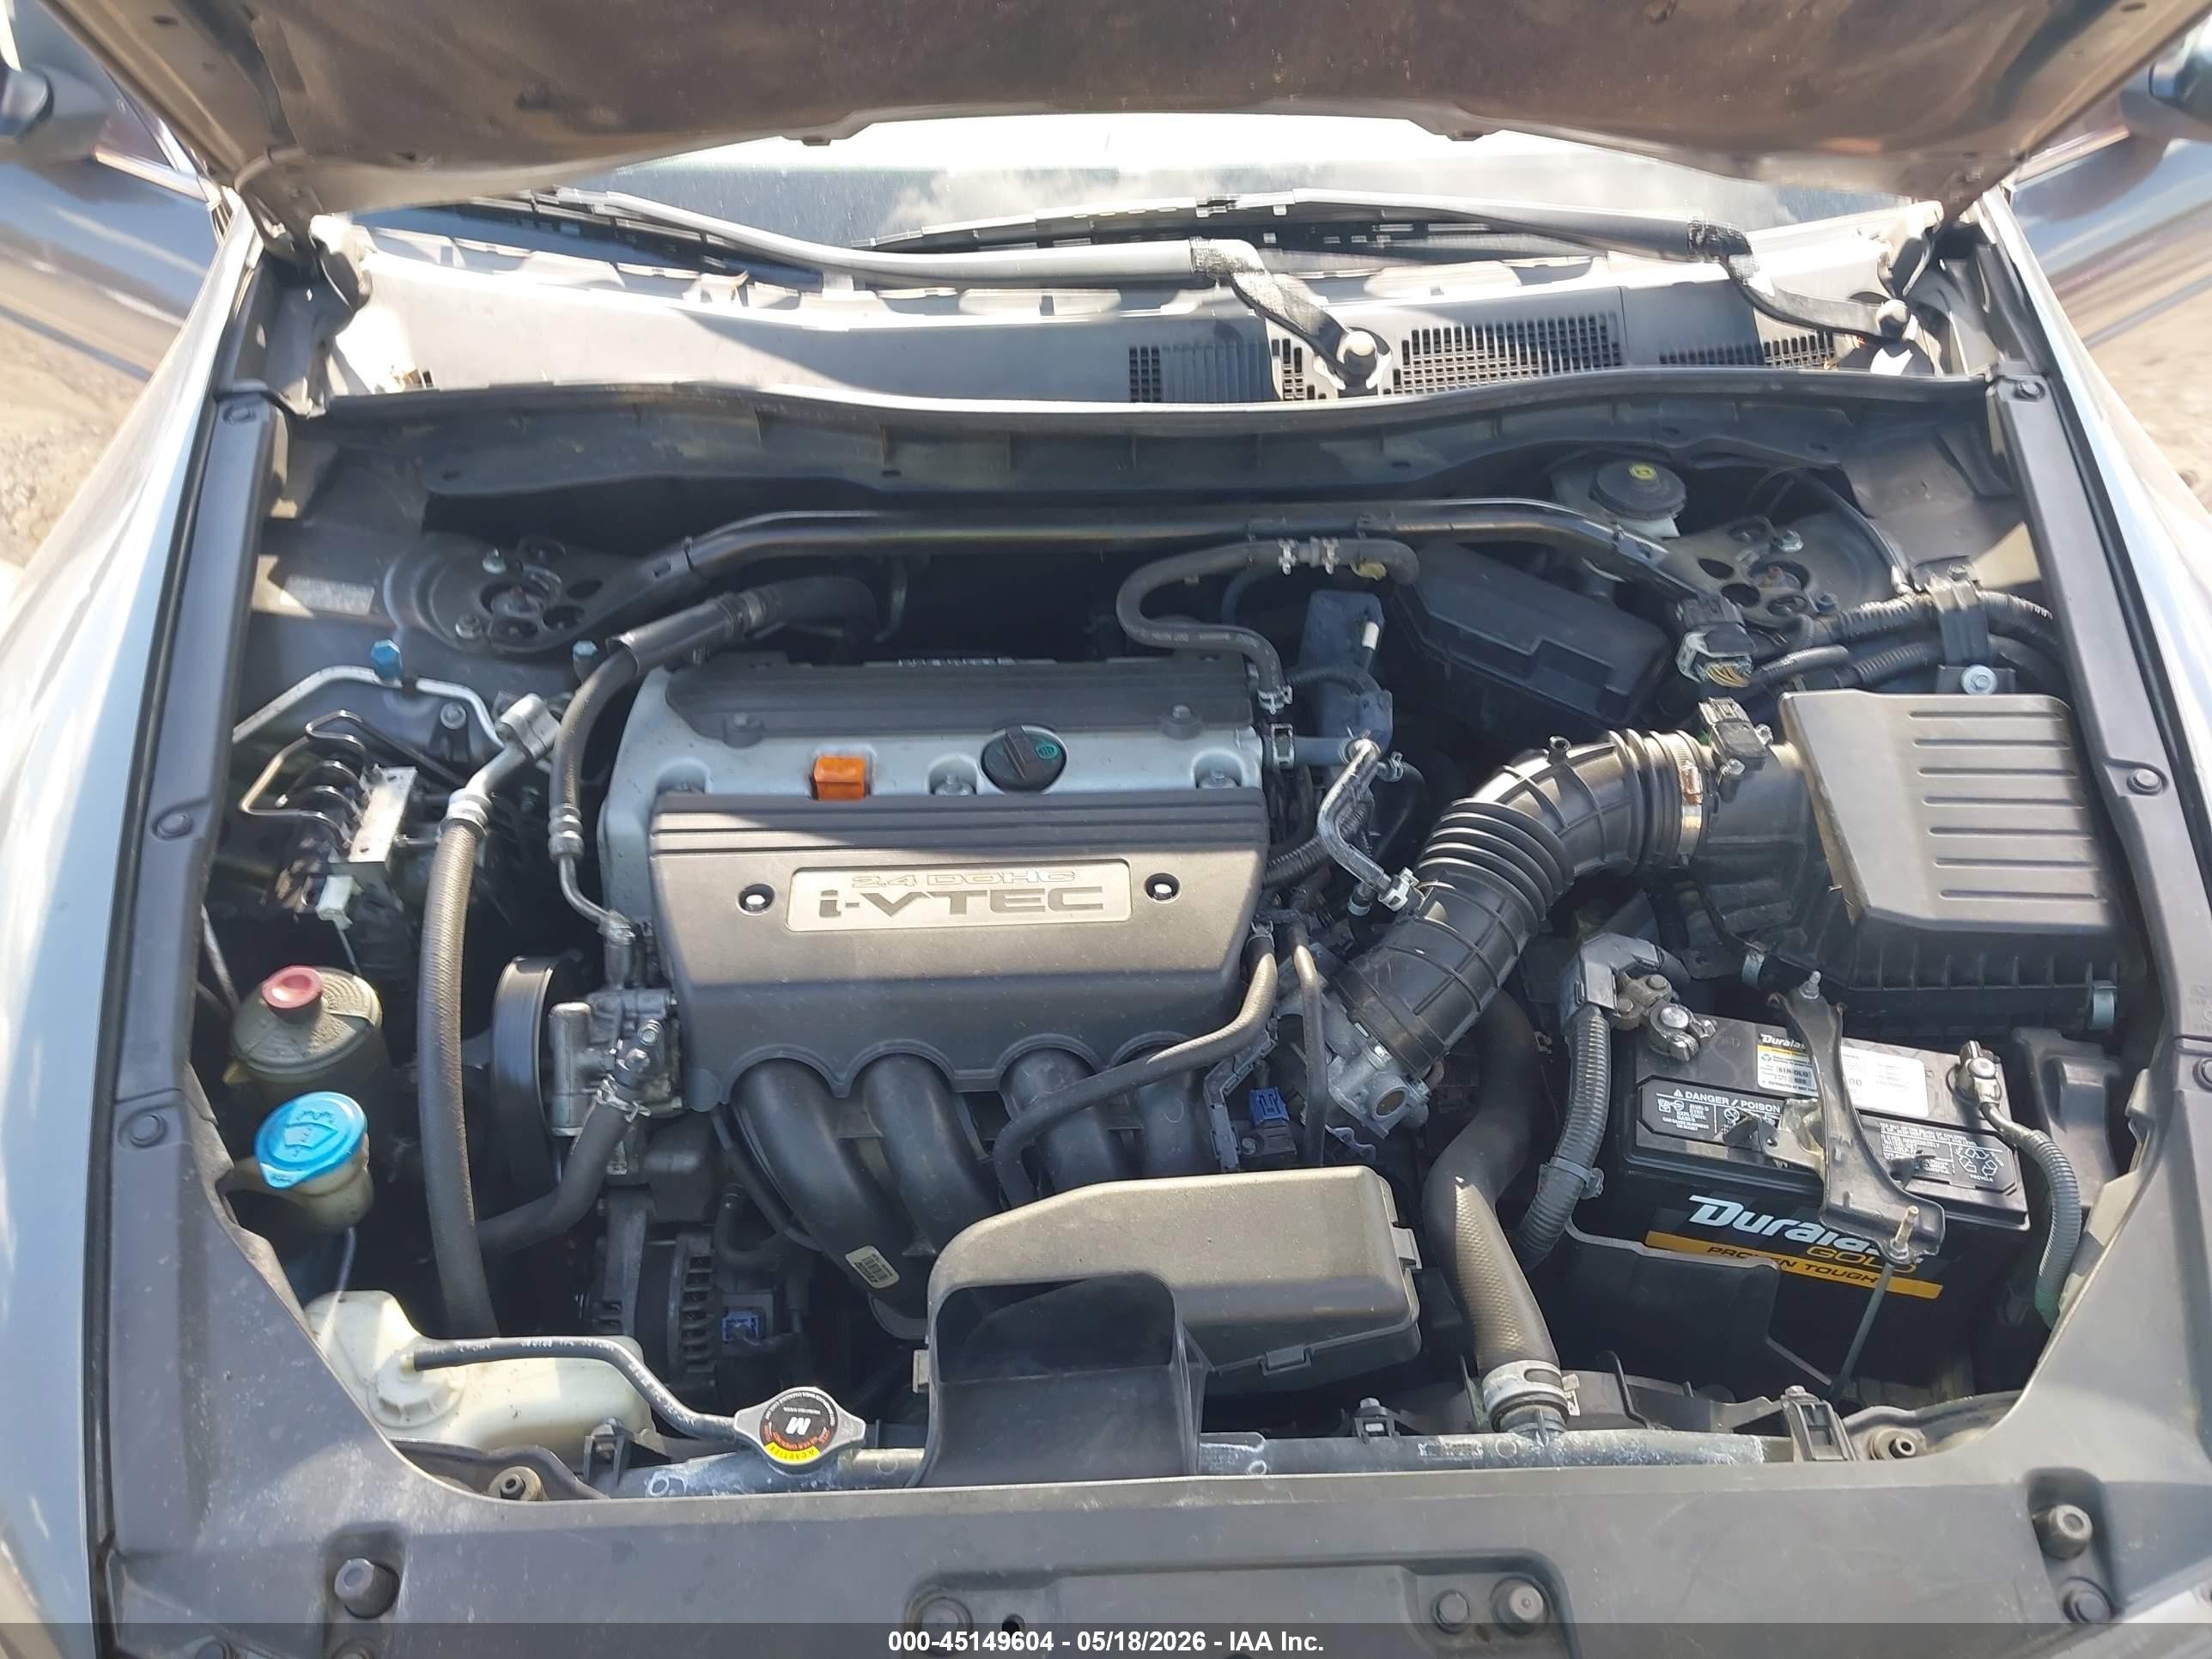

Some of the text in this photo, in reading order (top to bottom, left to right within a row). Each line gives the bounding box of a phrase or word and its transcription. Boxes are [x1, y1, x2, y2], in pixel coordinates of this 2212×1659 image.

[852, 870, 1076, 889] 2.4 DOHC
[818, 885, 1104, 918] i-VTEC
[1685, 1092, 1729, 1106] DANGER
[1740, 1100, 1781, 1114] POISON
[1804, 1263, 1880, 1283] TOUGH
